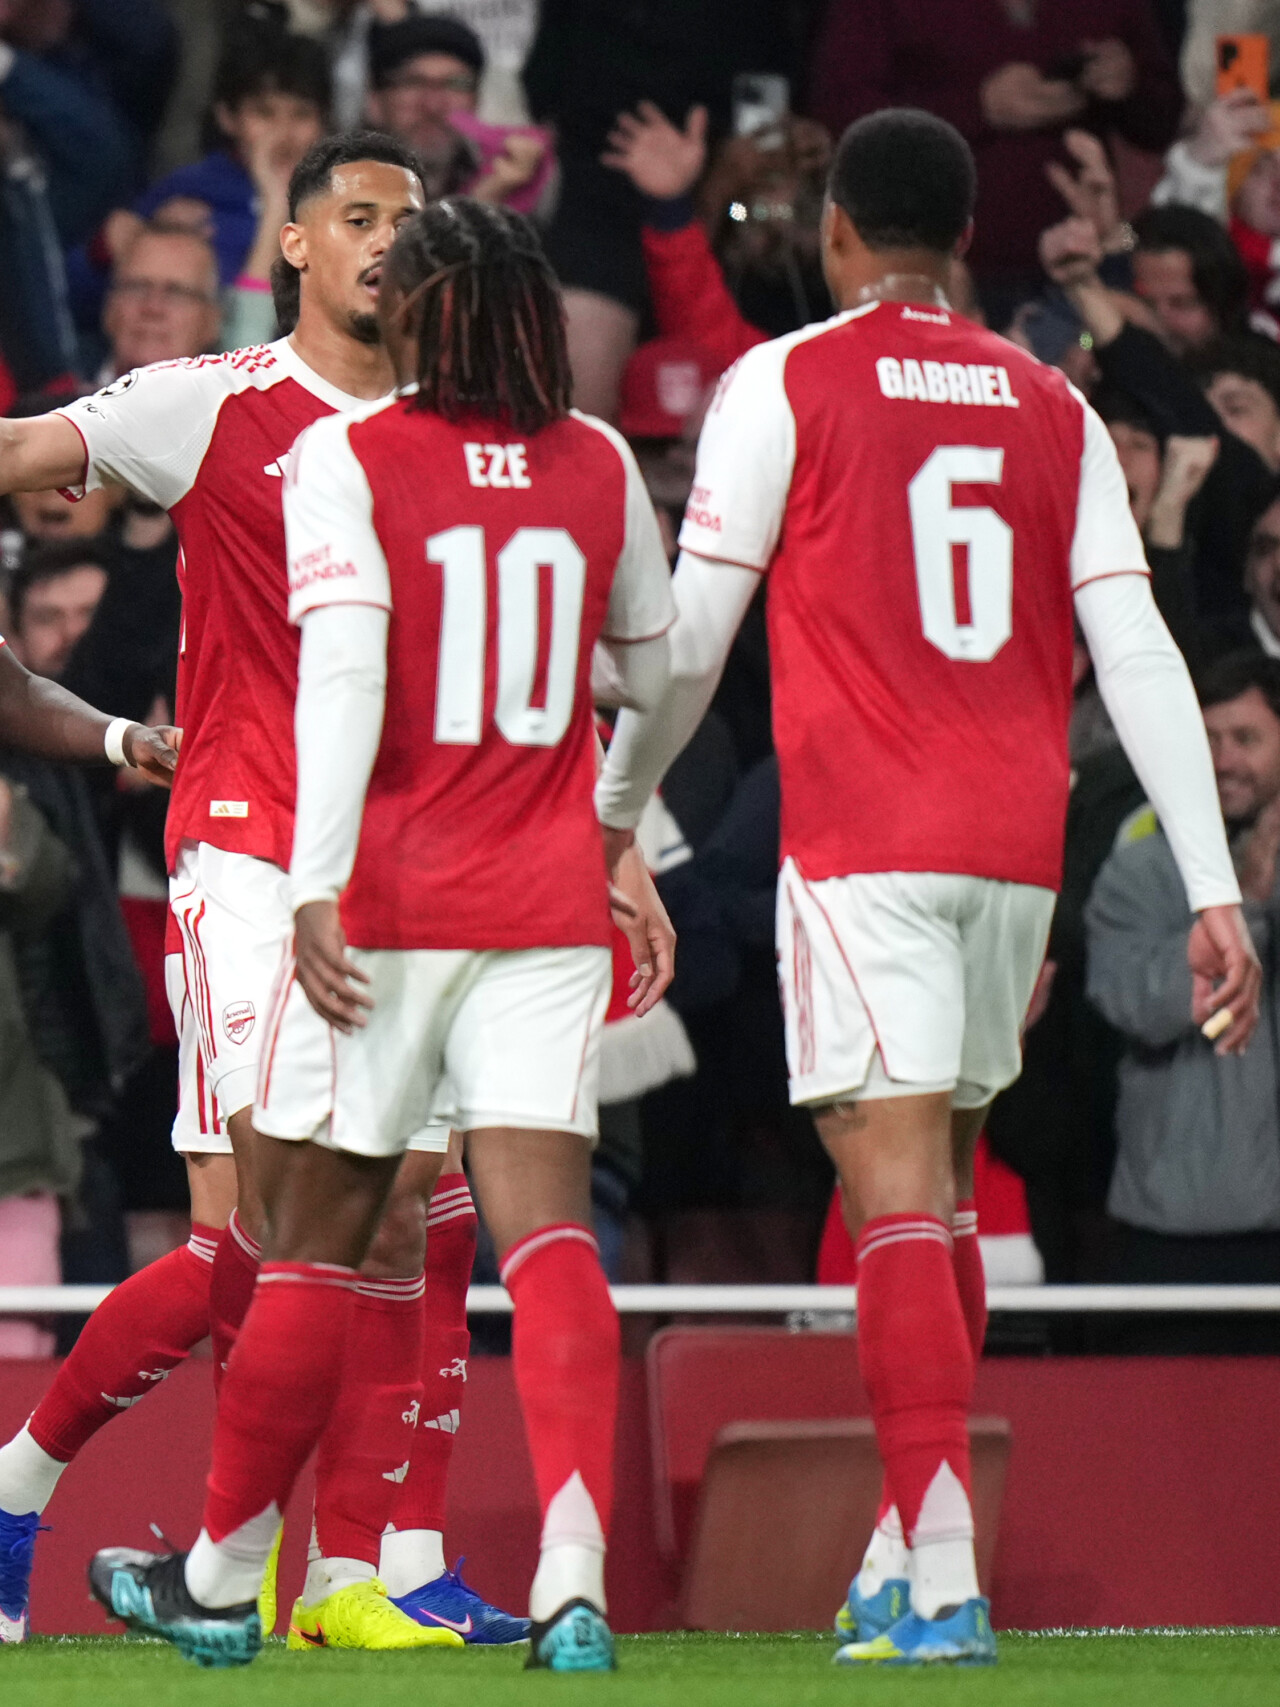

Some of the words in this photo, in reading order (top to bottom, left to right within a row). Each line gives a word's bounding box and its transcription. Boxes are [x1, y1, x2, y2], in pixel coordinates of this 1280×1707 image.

[875, 356, 1020, 409] GABRIEL
[463, 441, 532, 489] EZE
[907, 445, 1013, 662] 6
[426, 524, 587, 748] 10
